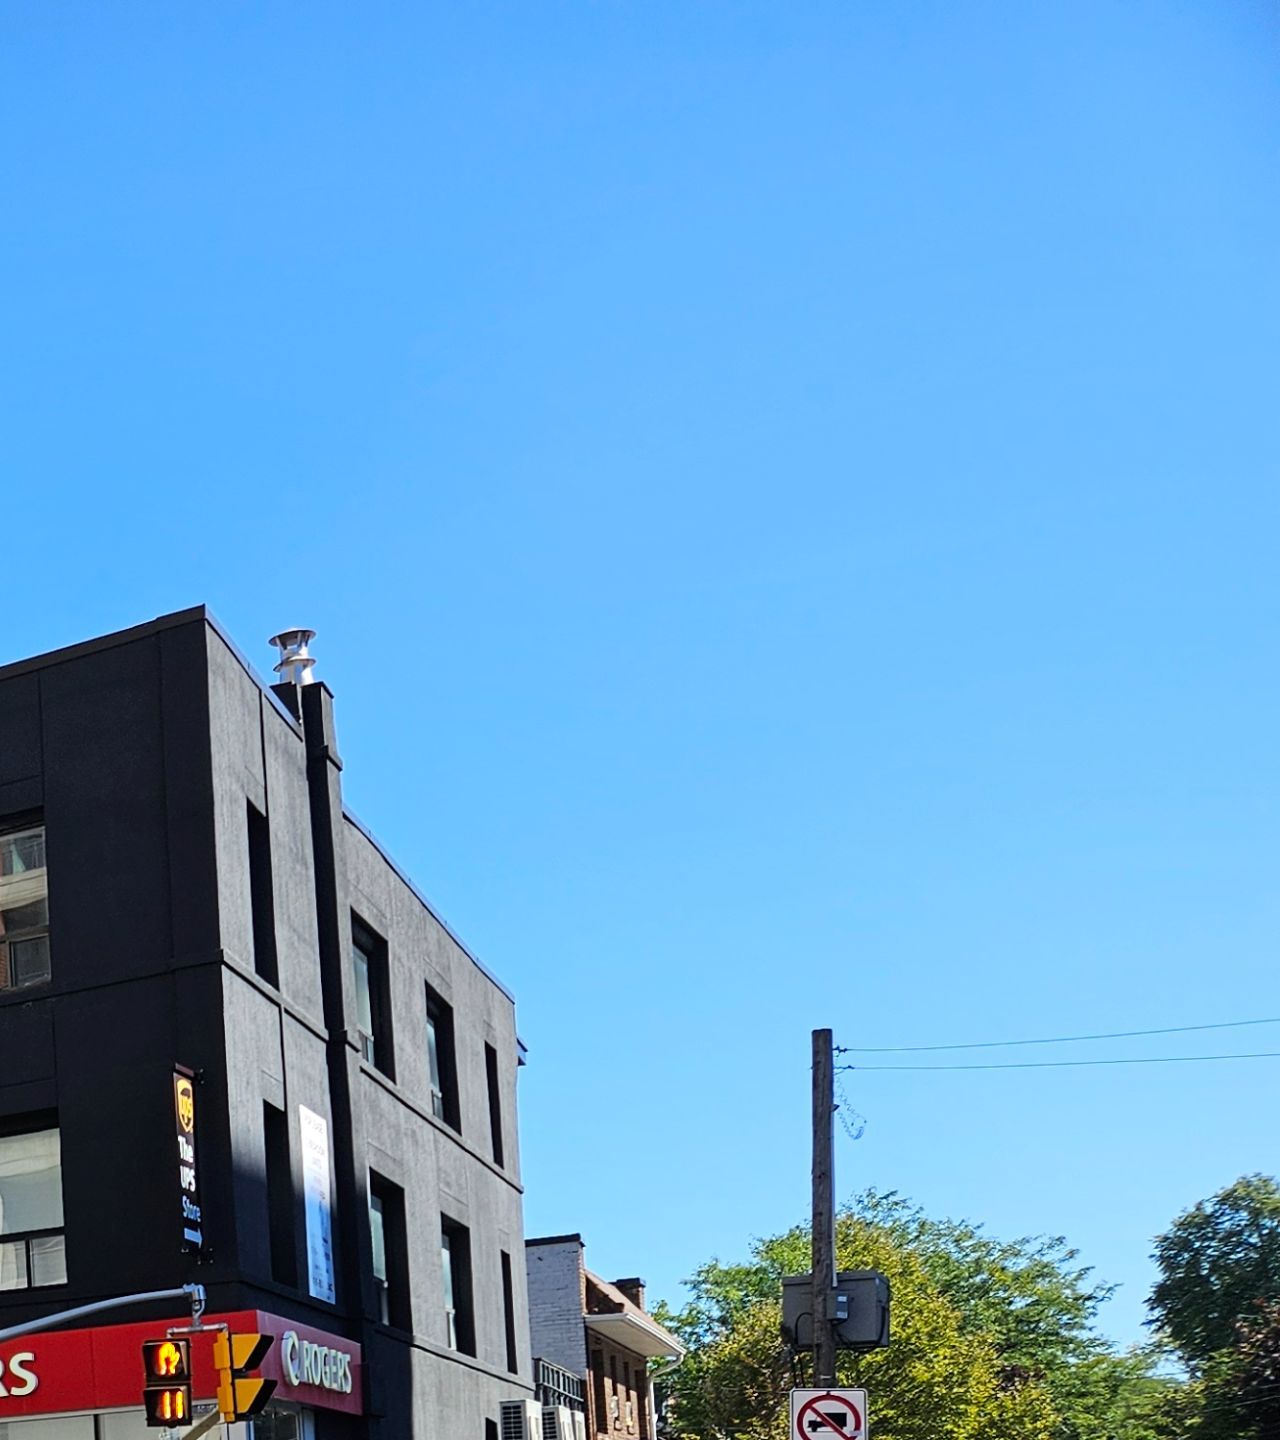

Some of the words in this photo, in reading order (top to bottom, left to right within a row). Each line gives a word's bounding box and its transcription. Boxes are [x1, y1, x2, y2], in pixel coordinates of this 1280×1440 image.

[177, 1135, 194, 1163] The
[179, 1165, 196, 1193] UPS
[182, 1194, 201, 1222] Store
[302, 1341, 352, 1394] ROGERS
